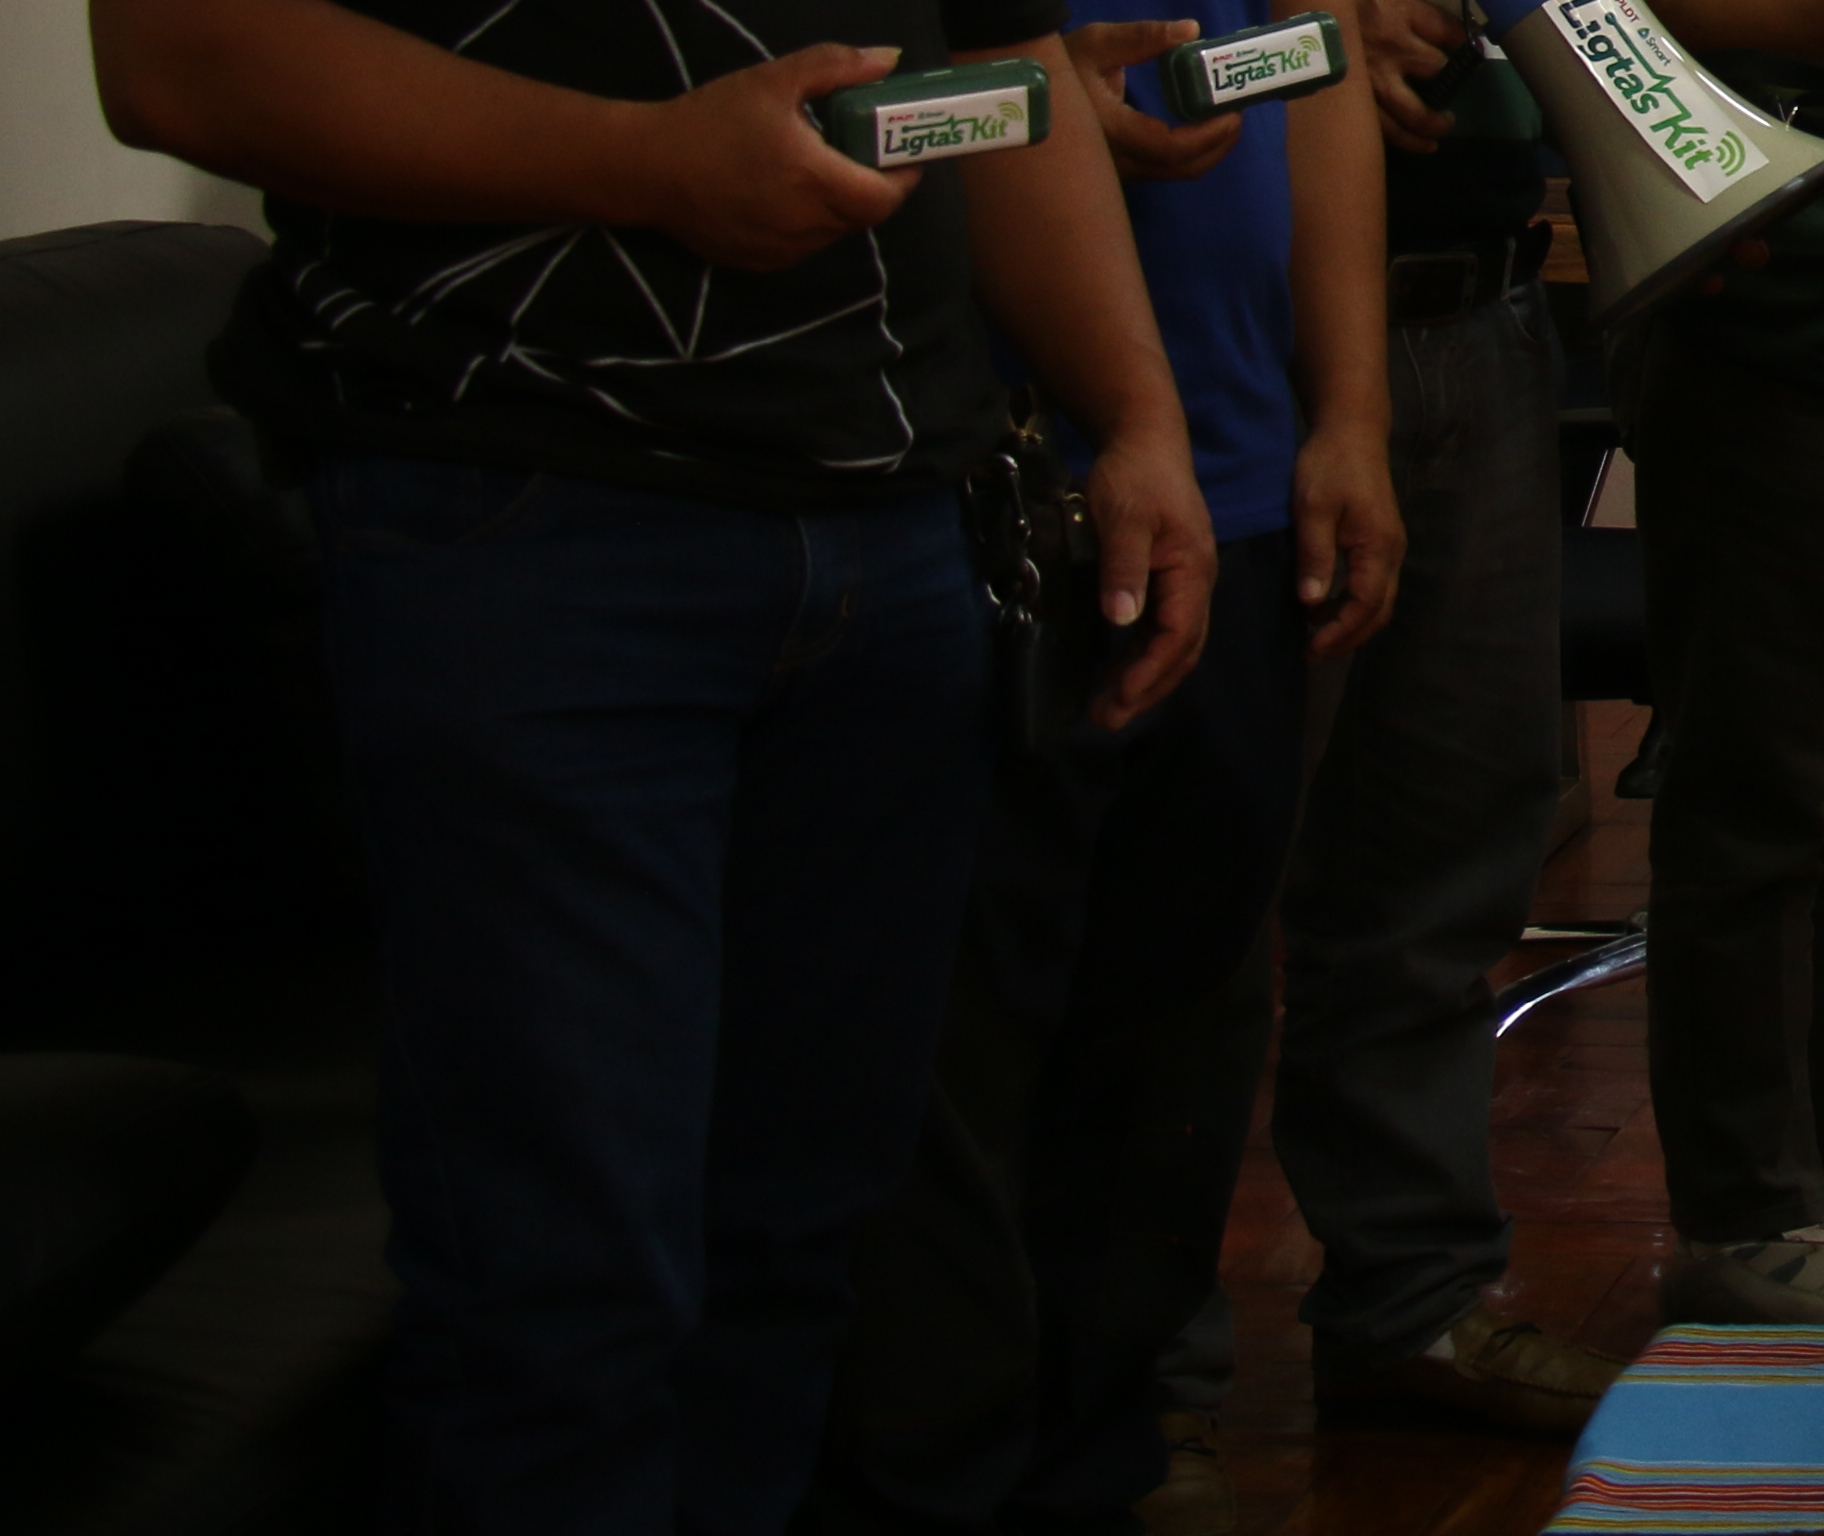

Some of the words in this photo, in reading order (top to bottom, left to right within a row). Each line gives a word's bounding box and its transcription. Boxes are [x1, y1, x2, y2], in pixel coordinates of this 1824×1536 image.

[1213, 63, 1276, 91] Ligtas
[1281, 49, 1310, 74] Kit
[1646, 36, 1671, 67] Smart
[884, 126, 965, 156] Ligtas
[969, 115, 1008, 143] Kit
[1650, 112, 1715, 171] Kit
